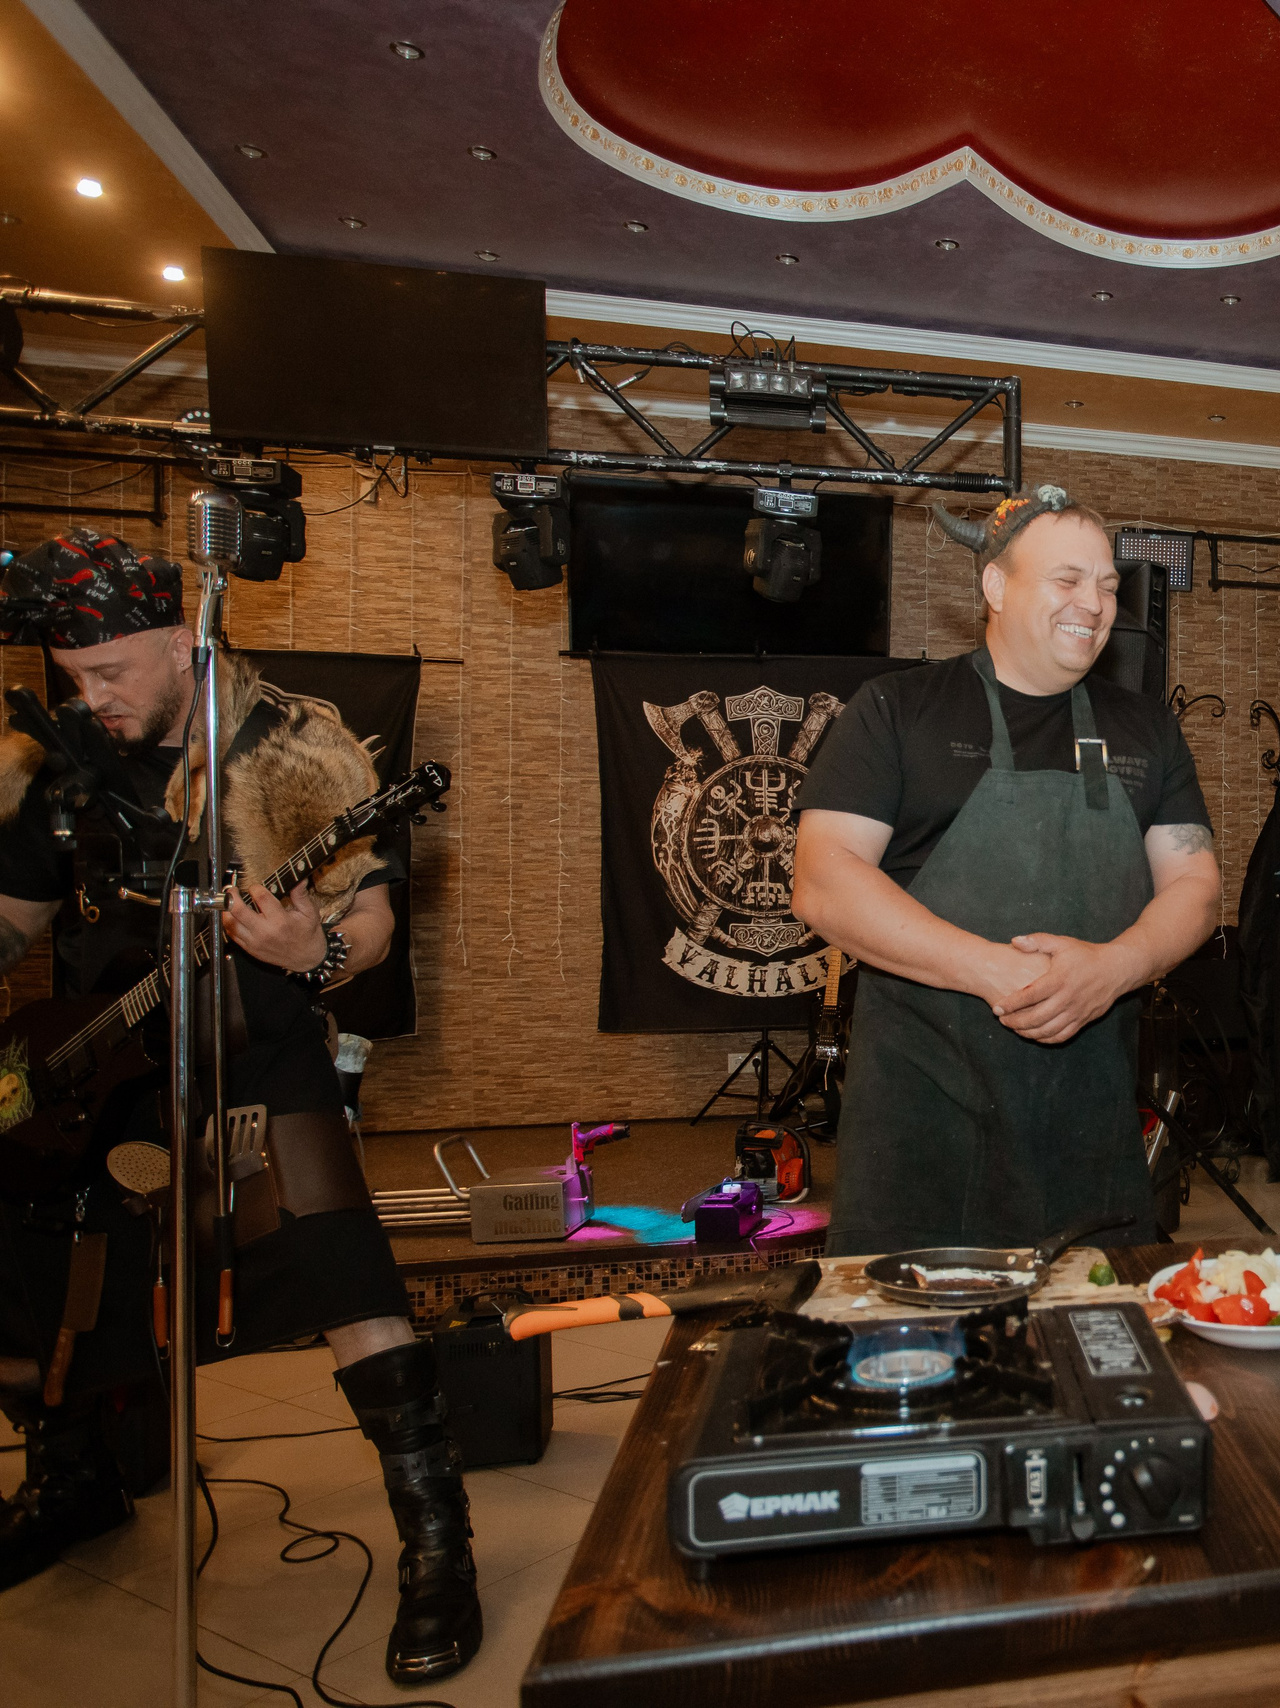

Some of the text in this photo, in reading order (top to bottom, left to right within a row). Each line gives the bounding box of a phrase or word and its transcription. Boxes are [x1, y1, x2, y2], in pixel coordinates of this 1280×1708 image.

[1108, 755, 1149, 768] LWAYS
[425, 764, 443, 787] LTD
[676, 943, 853, 993] VALHAL
[502, 1192, 560, 1211] Gatling
[494, 1218, 562, 1236] machine
